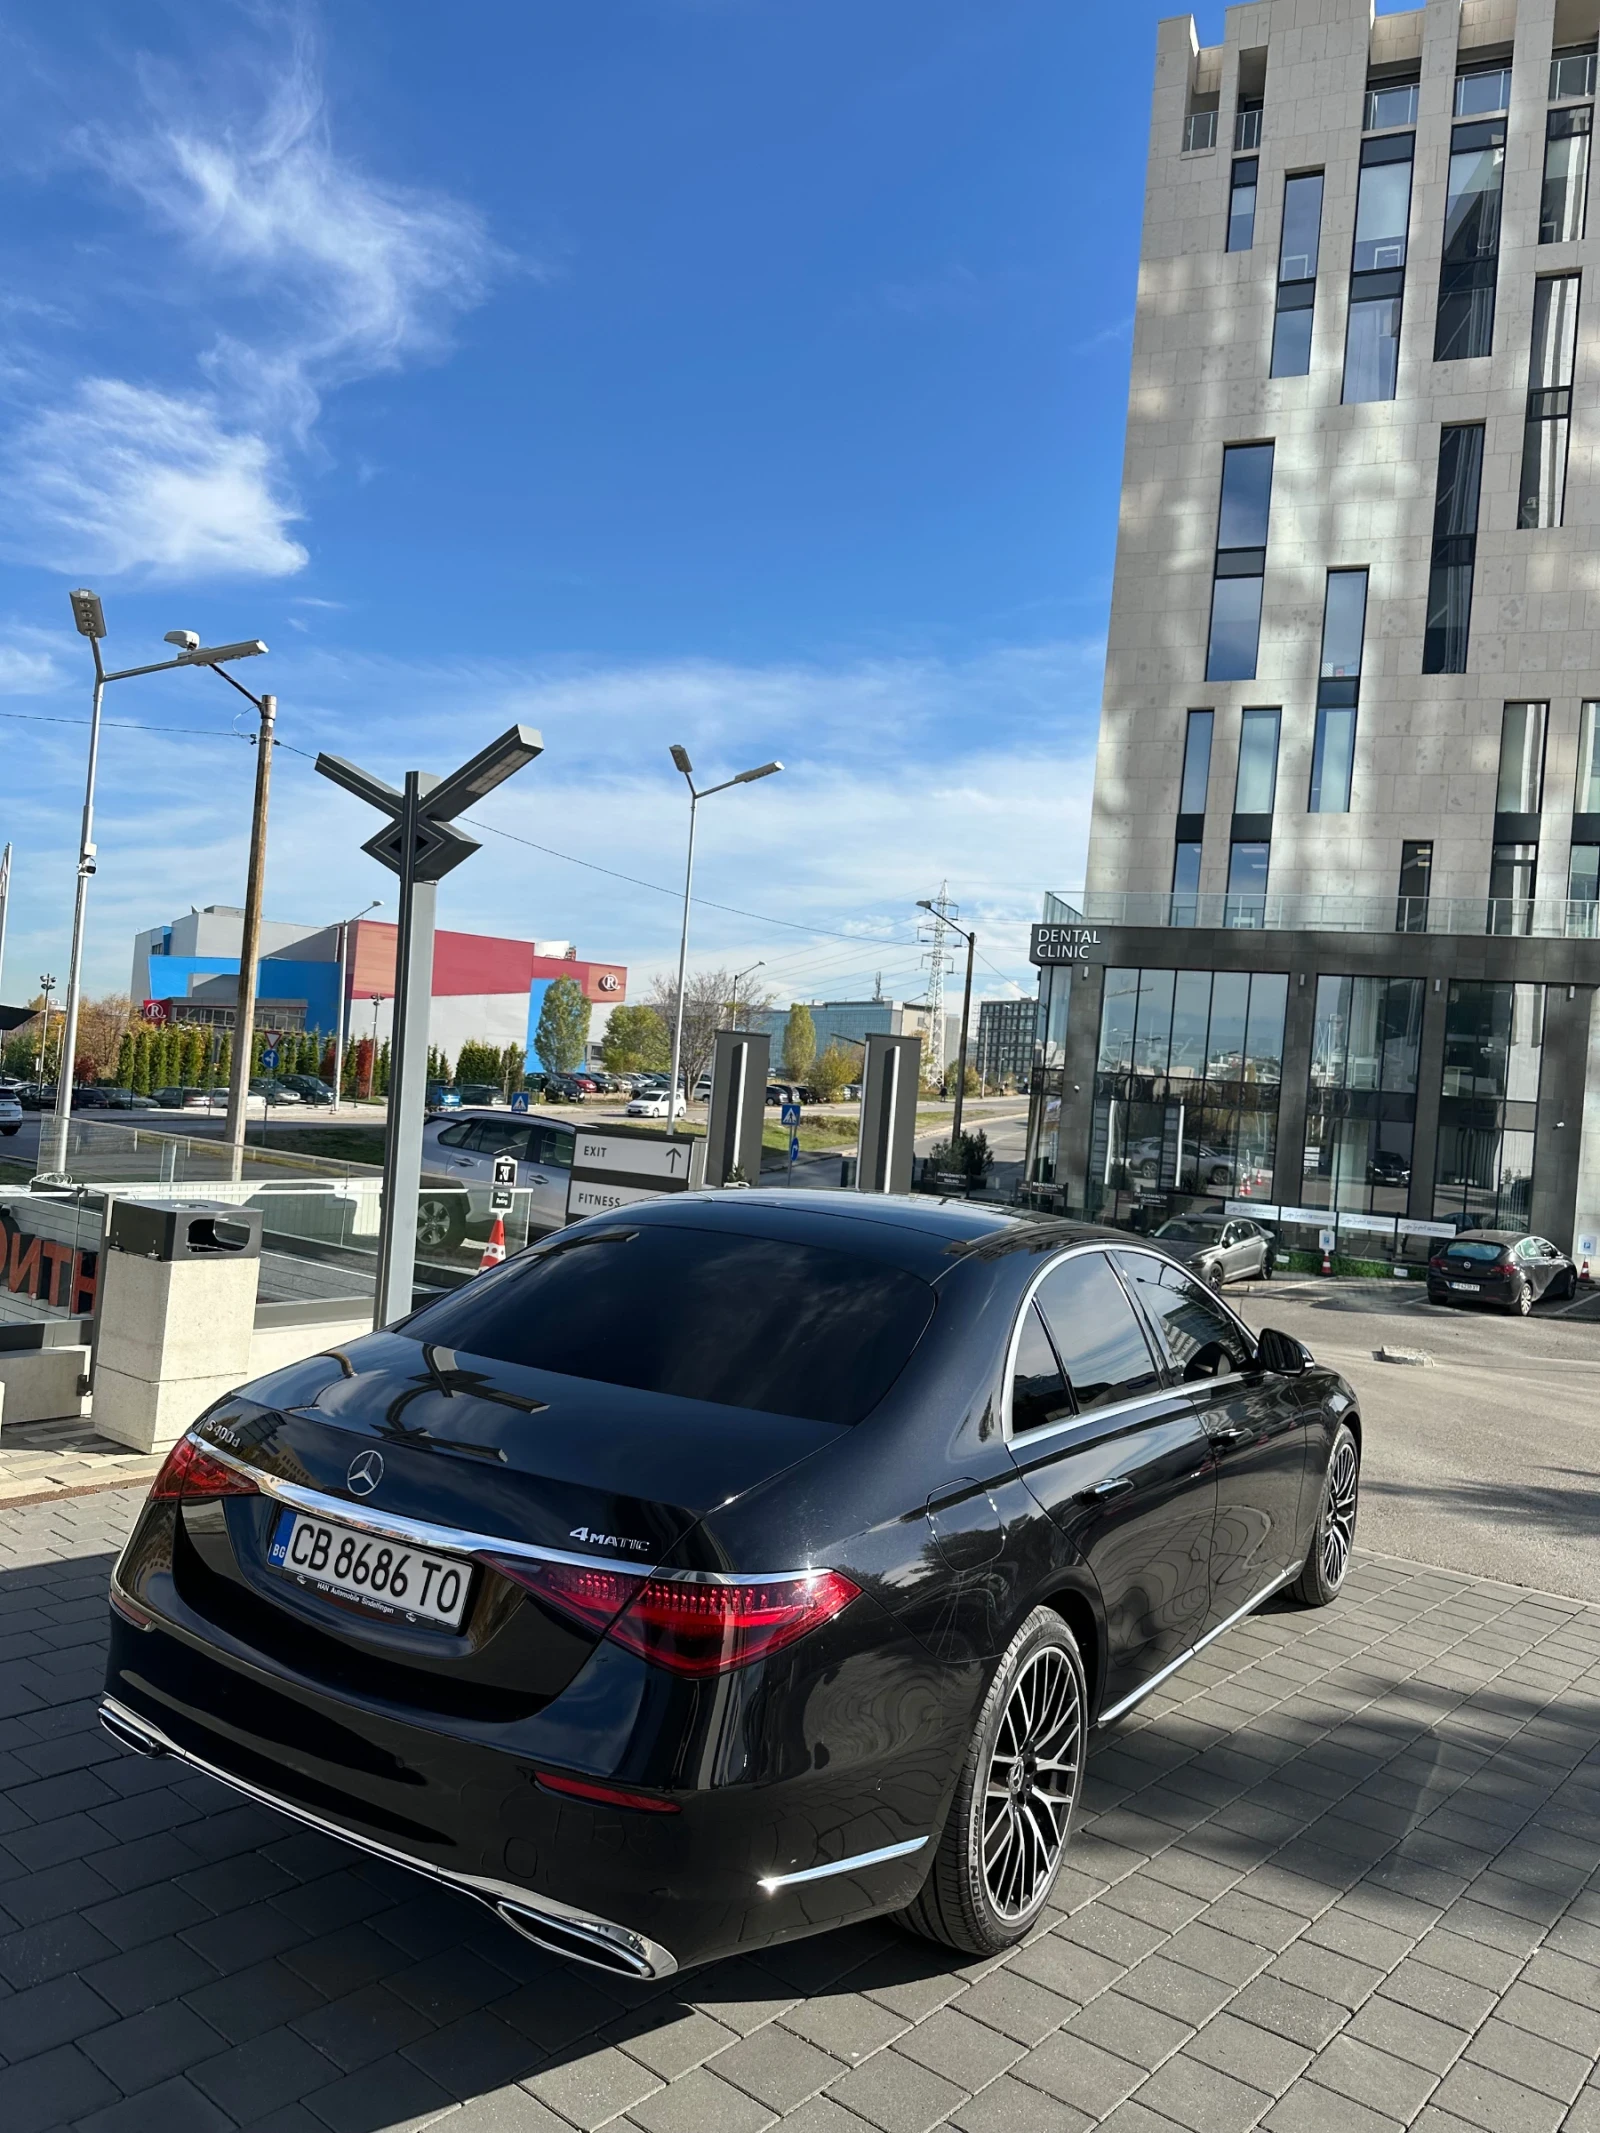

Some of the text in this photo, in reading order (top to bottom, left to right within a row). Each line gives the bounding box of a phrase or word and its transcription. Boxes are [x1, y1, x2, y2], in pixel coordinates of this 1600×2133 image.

[1038, 929, 1101, 944] DENTAL
[1036, 944, 1090, 959] CLINIC
[583, 1146, 607, 1158] EXIT
[578, 1193, 620, 1208] FITNESS
[569, 1526, 650, 1552] 4MATIC
[272, 1543, 286, 1559] BG
[291, 1523, 460, 1614] CB 8686 TO
[317, 1581, 394, 1615] HAN Automobile Sindelfingen
